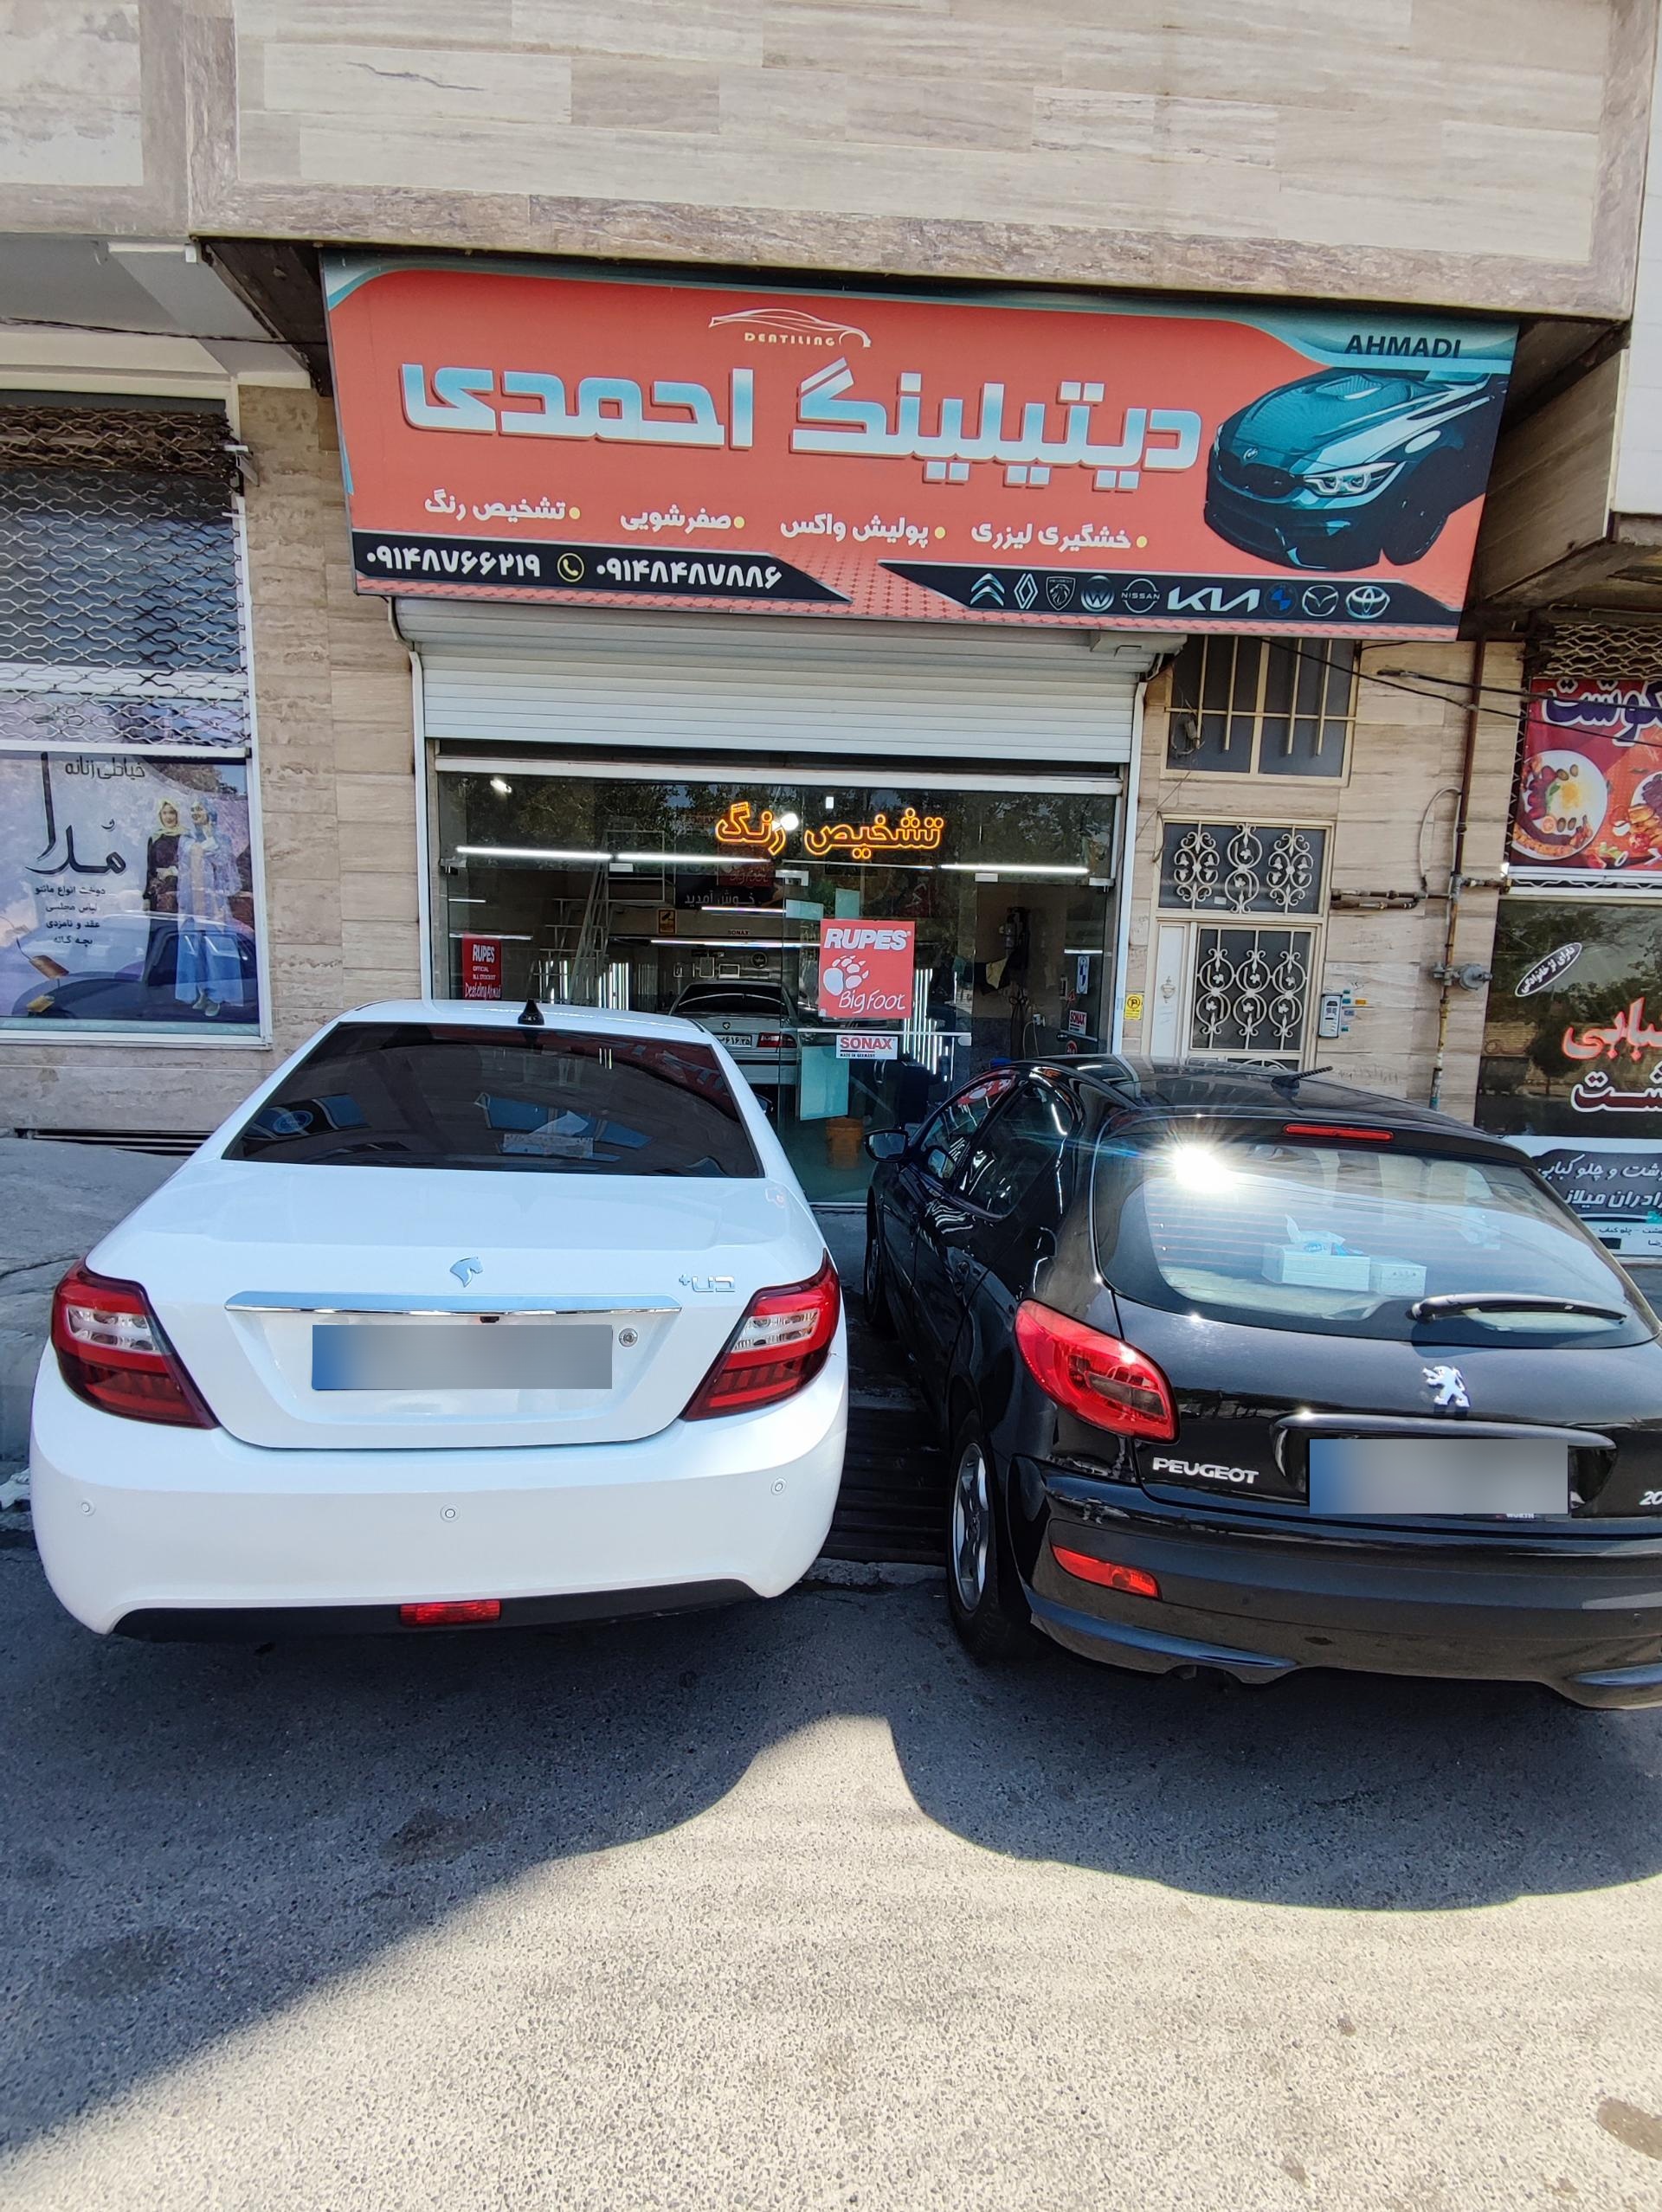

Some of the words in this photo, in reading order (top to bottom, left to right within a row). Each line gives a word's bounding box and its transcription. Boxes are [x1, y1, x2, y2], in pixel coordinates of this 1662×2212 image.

[1343, 334, 1462, 359] AHMADI
[401, 363, 755, 449] احمدی
[791, 357, 1202, 492] دیتیلینگ
[424, 488, 467, 520] رنگ
[473, 497, 566, 523] تشخیص
[780, 513, 847, 541] واکس
[852, 515, 930, 548] پولیش
[970, 523, 1034, 550] لیزری
[1037, 524, 1132, 553] خشگیری
[1121, 590, 1161, 601] NISSAN
[65, 755, 95, 778] زنانه
[97, 756, 145, 780] خیاطی
[715, 801, 788, 856] رنگ
[804, 807, 944, 860] تشخیص
[57, 885, 76, 897] انواع
[46, 919, 74, 929] نامزدی
[84, 920, 100, 929] عقد
[824, 928, 908, 951] RUPES
[472, 943, 495, 963] RUPES
[1562, 997, 1662, 1061] بابی
[840, 1037, 892, 1050] SONAX
[1607, 1168, 1618, 1180] و
[1152, 1457, 1259, 1485] PEUGEOT
[1639, 1490, 1662, 1506] 20
